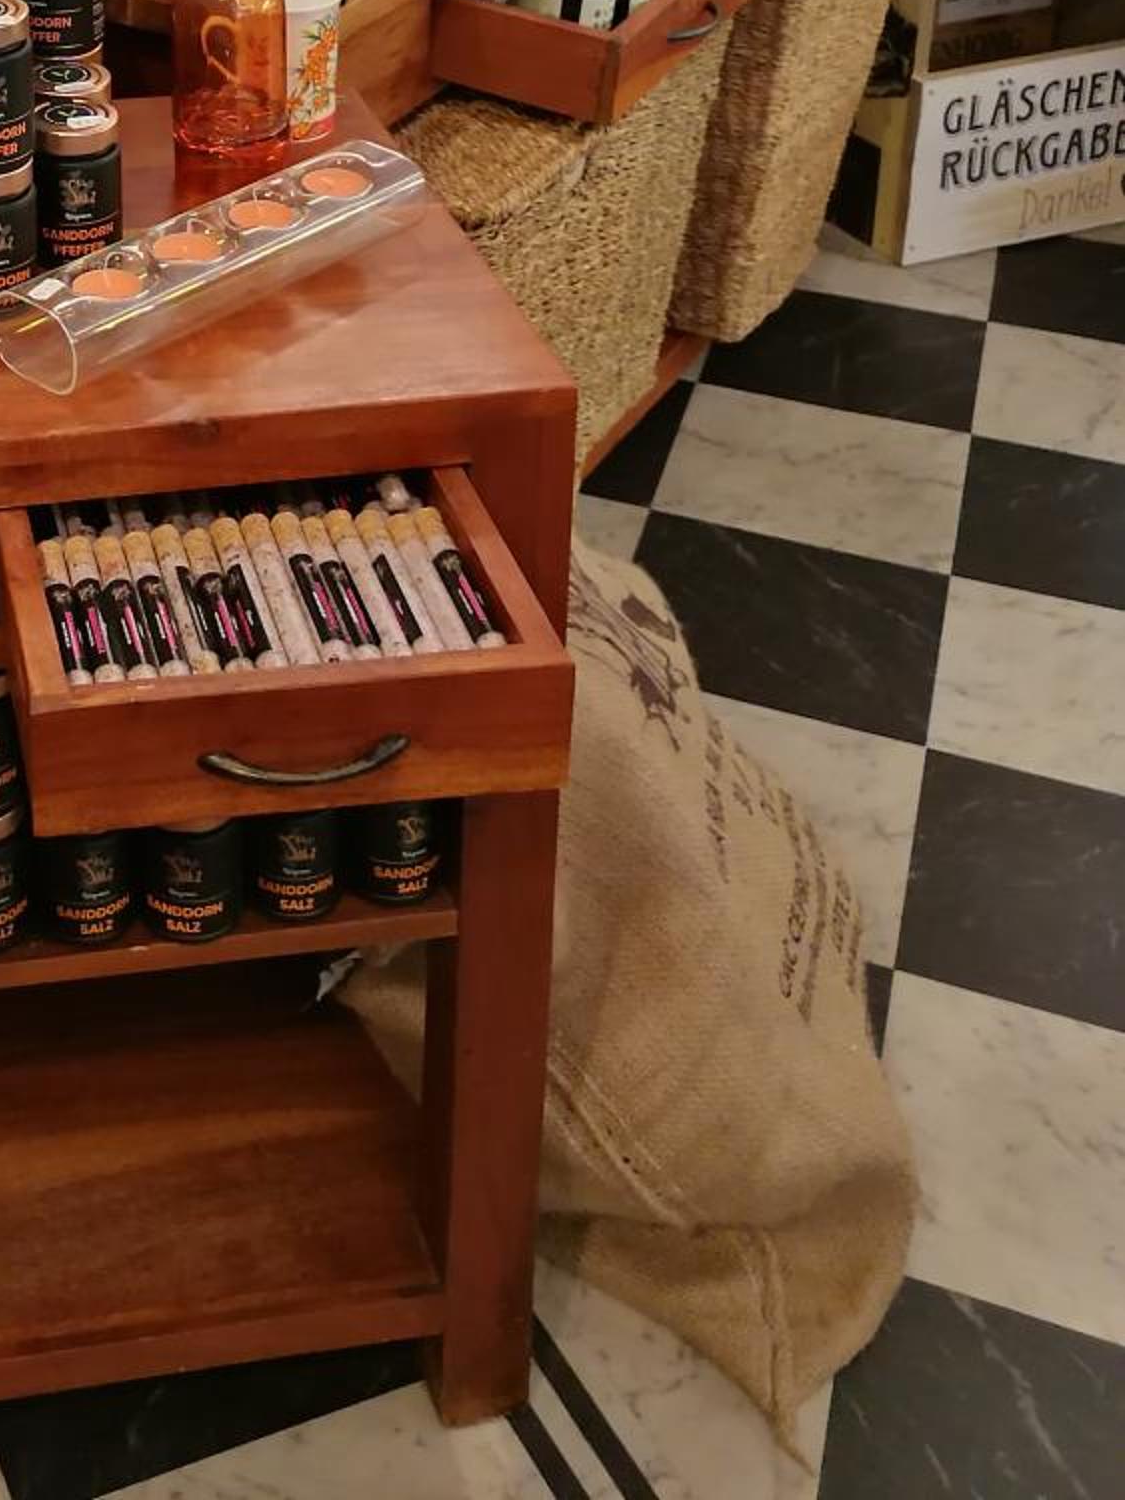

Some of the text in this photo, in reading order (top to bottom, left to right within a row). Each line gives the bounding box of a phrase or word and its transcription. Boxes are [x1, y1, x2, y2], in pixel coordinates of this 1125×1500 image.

[942, 68, 1125, 135] GLÄSCHEN
[939, 119, 1125, 190] RÜCKGABE
[279, 897, 315, 911] SALZ
[80, 919, 114, 936] SALZ
[166, 919, 202, 933] SALZ
